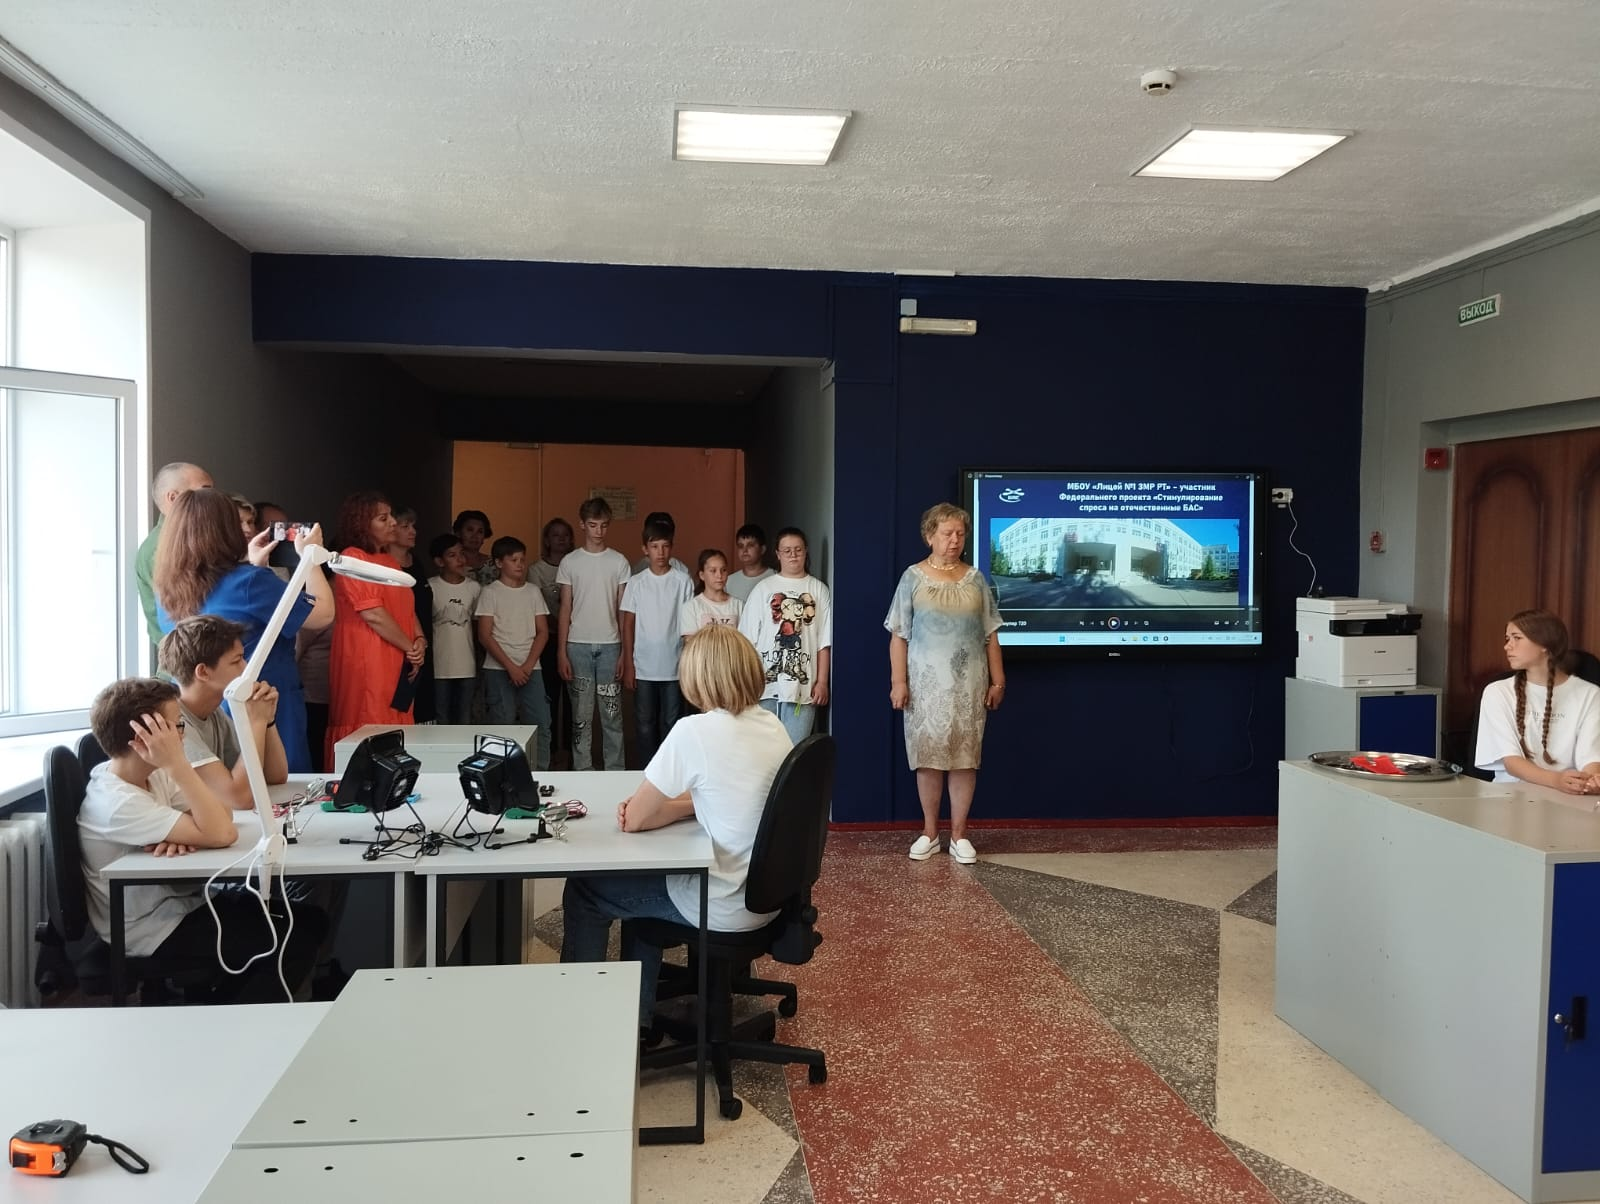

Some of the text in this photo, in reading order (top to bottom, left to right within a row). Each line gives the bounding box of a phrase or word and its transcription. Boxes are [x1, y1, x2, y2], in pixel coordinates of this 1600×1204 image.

[1460, 299, 1494, 321] ВЫХОД
[1066, 482, 1091, 490] МБОУ
[1092, 481, 1123, 491] «Лицей
[1179, 484, 1216, 492] участник
[1059, 493, 1224, 503] Федерального проекта «Стимулирование
[1079, 505, 1107, 513] спроса
